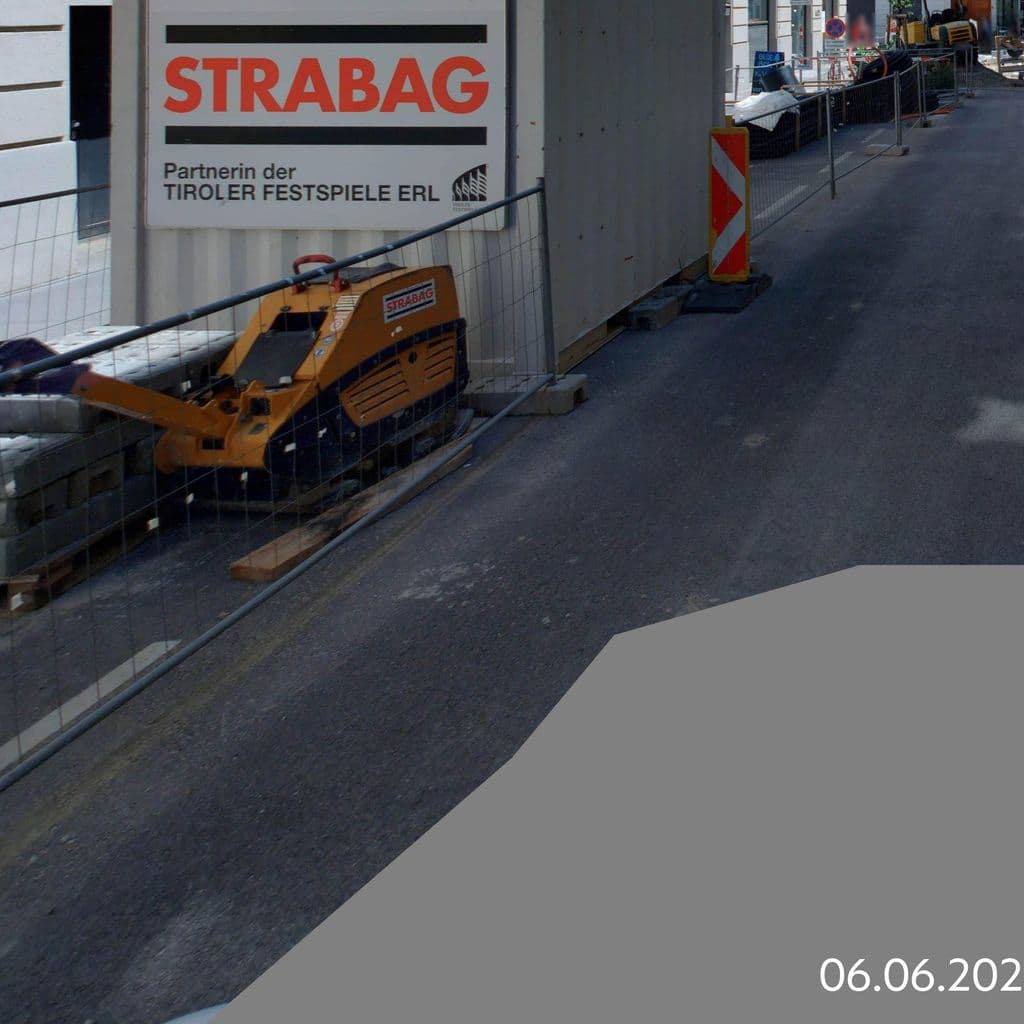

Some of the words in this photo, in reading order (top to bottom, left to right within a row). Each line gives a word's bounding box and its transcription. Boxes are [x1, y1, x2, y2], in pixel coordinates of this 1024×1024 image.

[164, 56, 489, 114] STRABAG
[164, 162, 256, 180] Partnerin
[263, 162, 296, 180] der
[164, 184, 256, 202] TIROLER
[263, 184, 394, 202] FESTSPIELE
[399, 184, 440, 202] ERL
[386, 288, 433, 313] STRABAG
